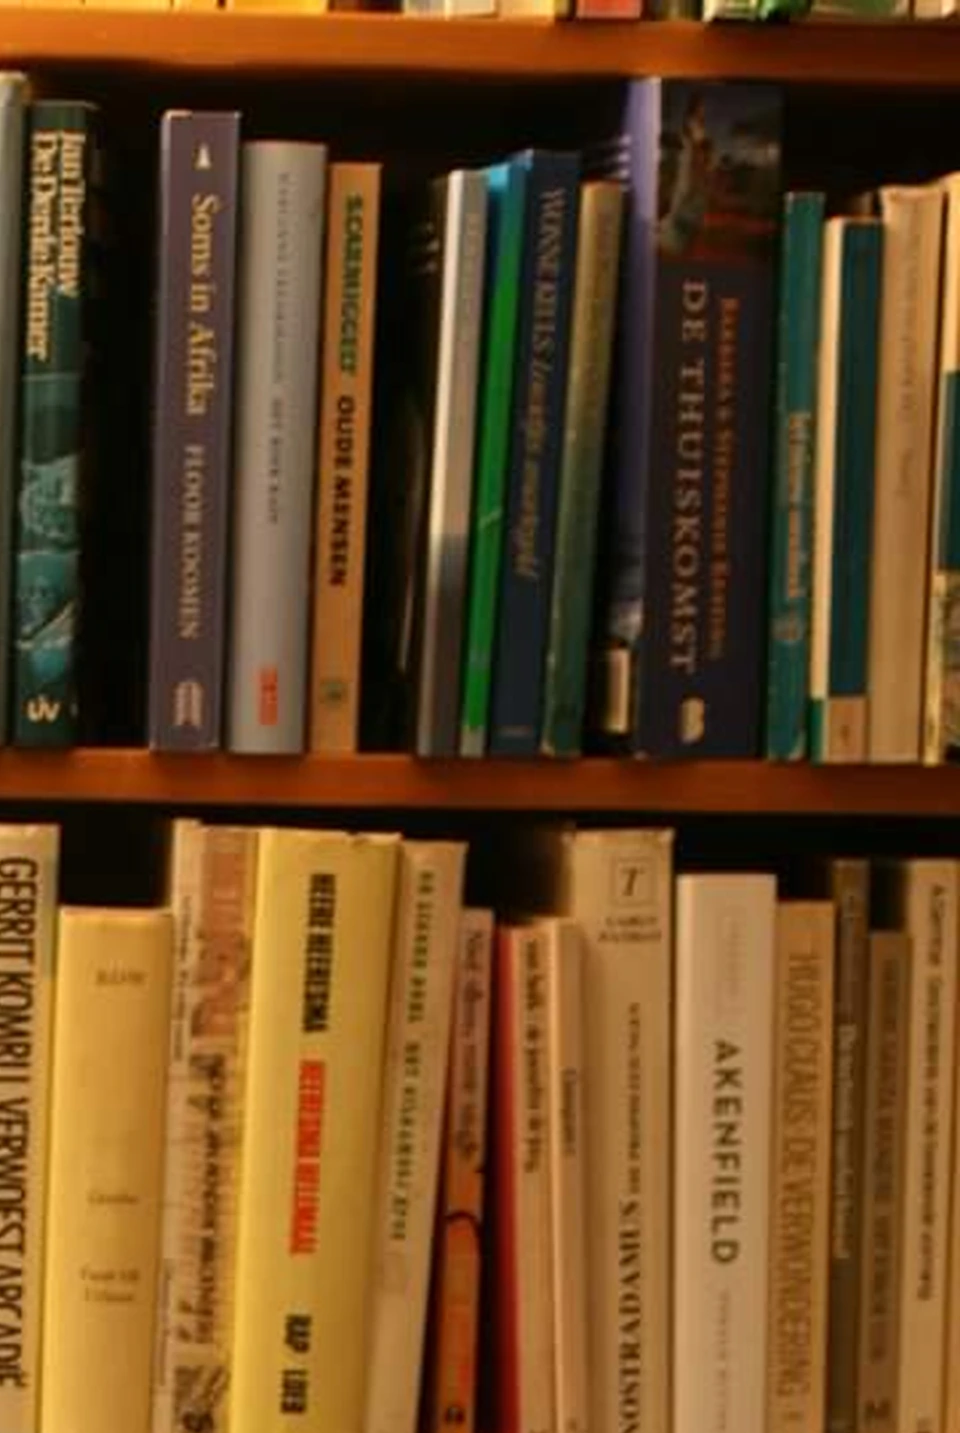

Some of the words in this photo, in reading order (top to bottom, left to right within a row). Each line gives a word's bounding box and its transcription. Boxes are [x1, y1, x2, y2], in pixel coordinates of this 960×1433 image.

[31, 132, 57, 165] De
[58, 132, 84, 181] Jan
[28, 166, 57, 252] Derde
[57, 184, 82, 296] Terlouw
[191, 194, 218, 276] Soms
[26, 255, 54, 361] Kamer
[190, 282, 215, 312] in
[682, 280, 706, 343] DE
[186, 322, 214, 415] Afrika
[335, 395, 356, 469] OUDE
[328, 477, 351, 586] MENSEN
[670, 364, 704, 674] THUISKOMST
[307, 874, 335, 930] HEERE
[786, 954, 819, 1032] HUGO
[711, 1040, 743, 1265] AKENFIELD
[784, 1139, 816, 1177] DE
[777, 1185, 816, 1397] VERWONDERING
[285, 1315, 310, 1352] RAP
